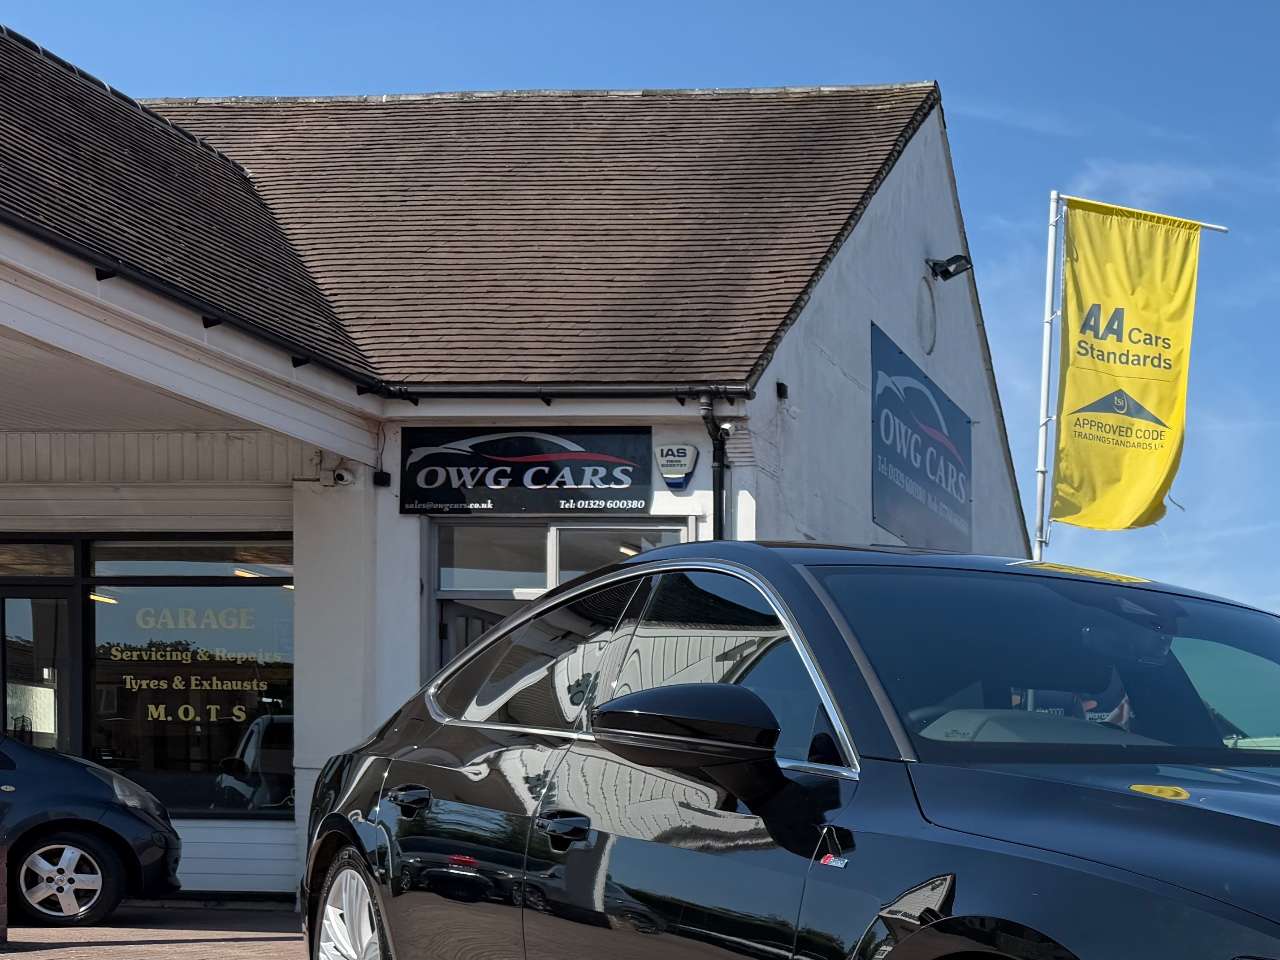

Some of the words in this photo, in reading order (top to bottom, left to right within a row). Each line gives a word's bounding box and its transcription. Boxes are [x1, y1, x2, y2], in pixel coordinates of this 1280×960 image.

[1080, 303, 1125, 343] AA
[1128, 327, 1172, 350] Cars
[1076, 340, 1173, 370] Standards
[1073, 417, 1133, 438] APPROVED
[1135, 429, 1166, 441] CODE
[660, 448, 687, 458] IAS
[879, 408, 922, 469] OWG
[926, 446, 967, 504] CARS
[416, 466, 513, 490] OWG
[522, 465, 633, 490] CARS
[560, 499, 576, 509] Tel:
[577, 499, 606, 509] 01329
[606, 499, 646, 511] 600380
[135, 607, 256, 629] GARAGE
[110, 646, 192, 663] Servicing
[196, 648, 210, 661] &
[122, 675, 168, 691] Tyres
[172, 675, 186, 690] &
[190, 675, 268, 691] Exhausts
